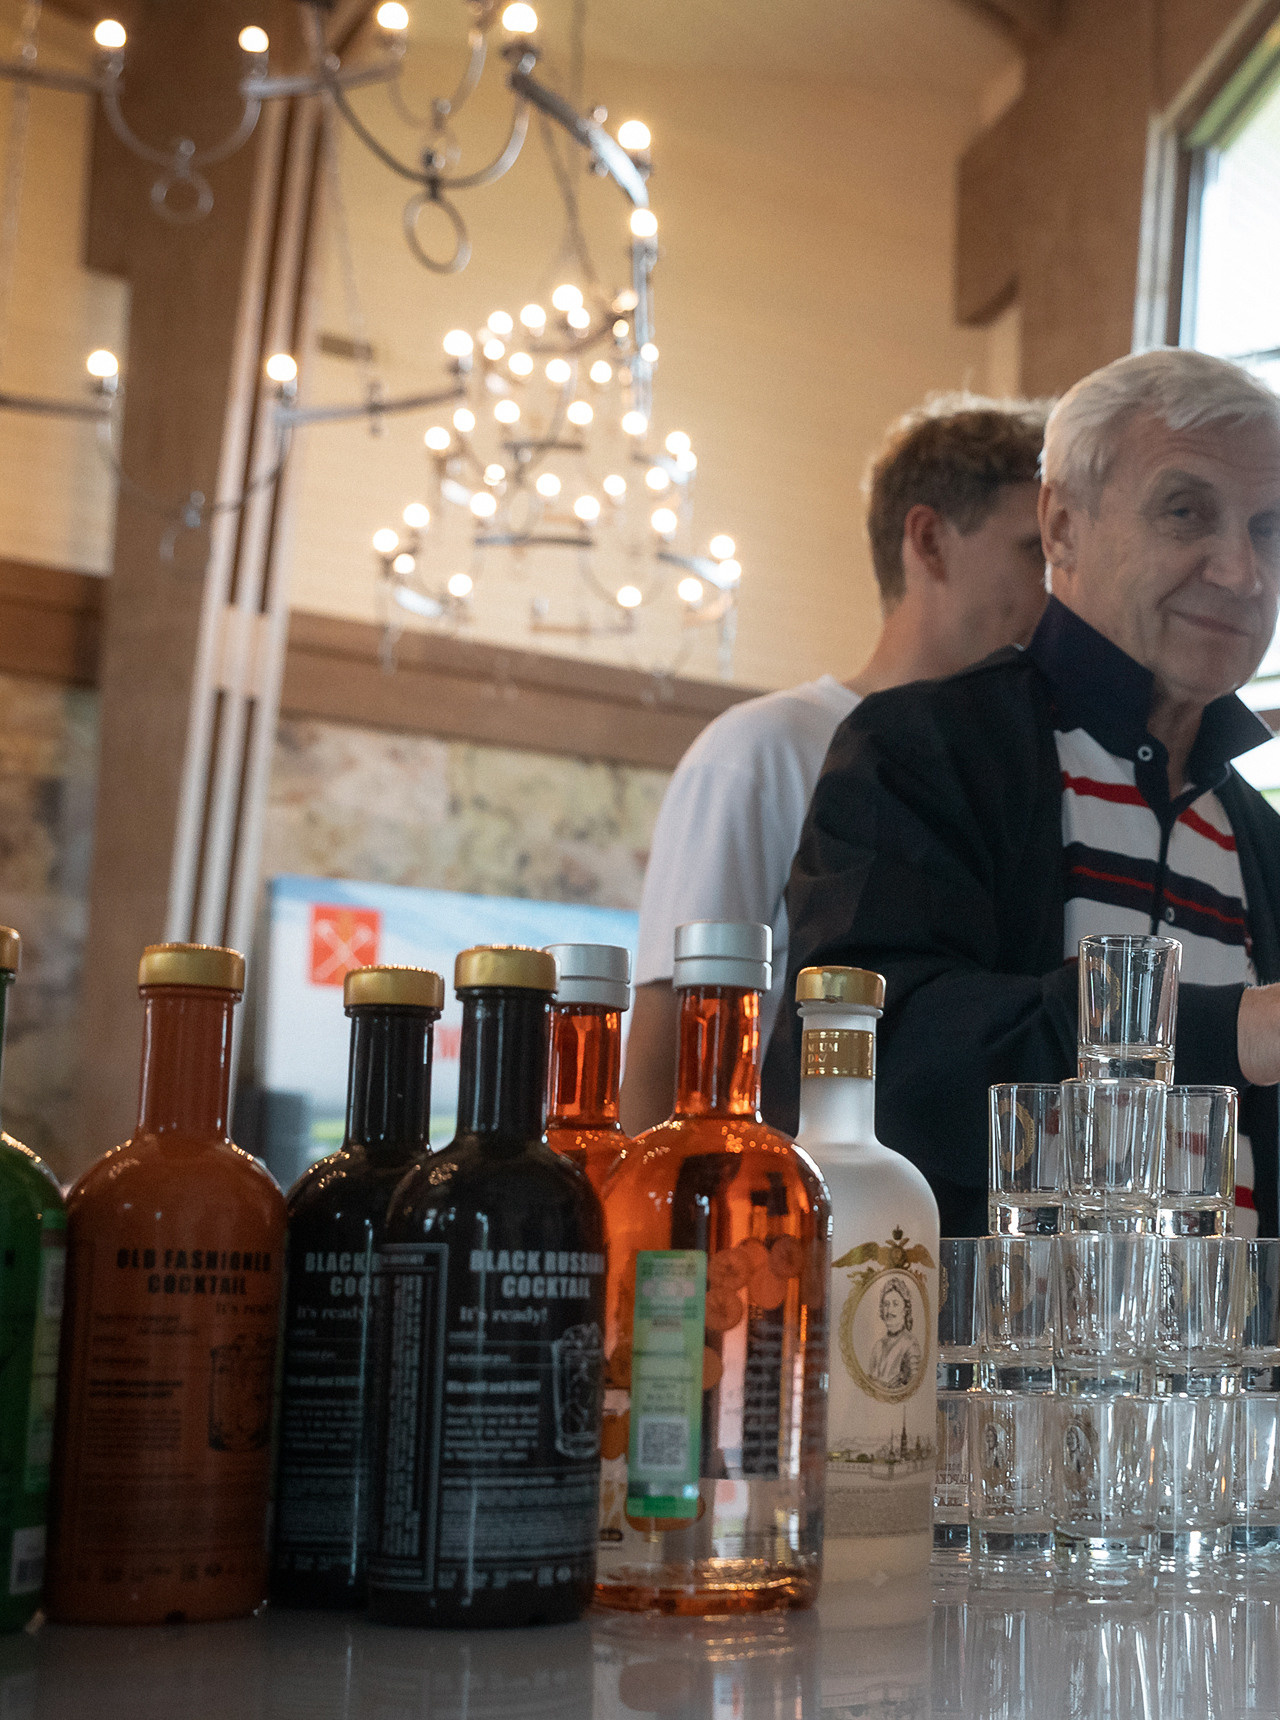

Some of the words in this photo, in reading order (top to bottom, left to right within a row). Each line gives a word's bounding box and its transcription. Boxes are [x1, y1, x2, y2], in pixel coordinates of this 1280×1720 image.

[164, 1249, 272, 1271] FASHIONED
[305, 1252, 366, 1273] BLACK
[470, 1249, 542, 1272] BLACK
[147, 1273, 247, 1295] COCKTAIL
[502, 1275, 591, 1299] COCKTAIL
[459, 1306, 488, 1323] It's
[492, 1306, 548, 1326] ready!
